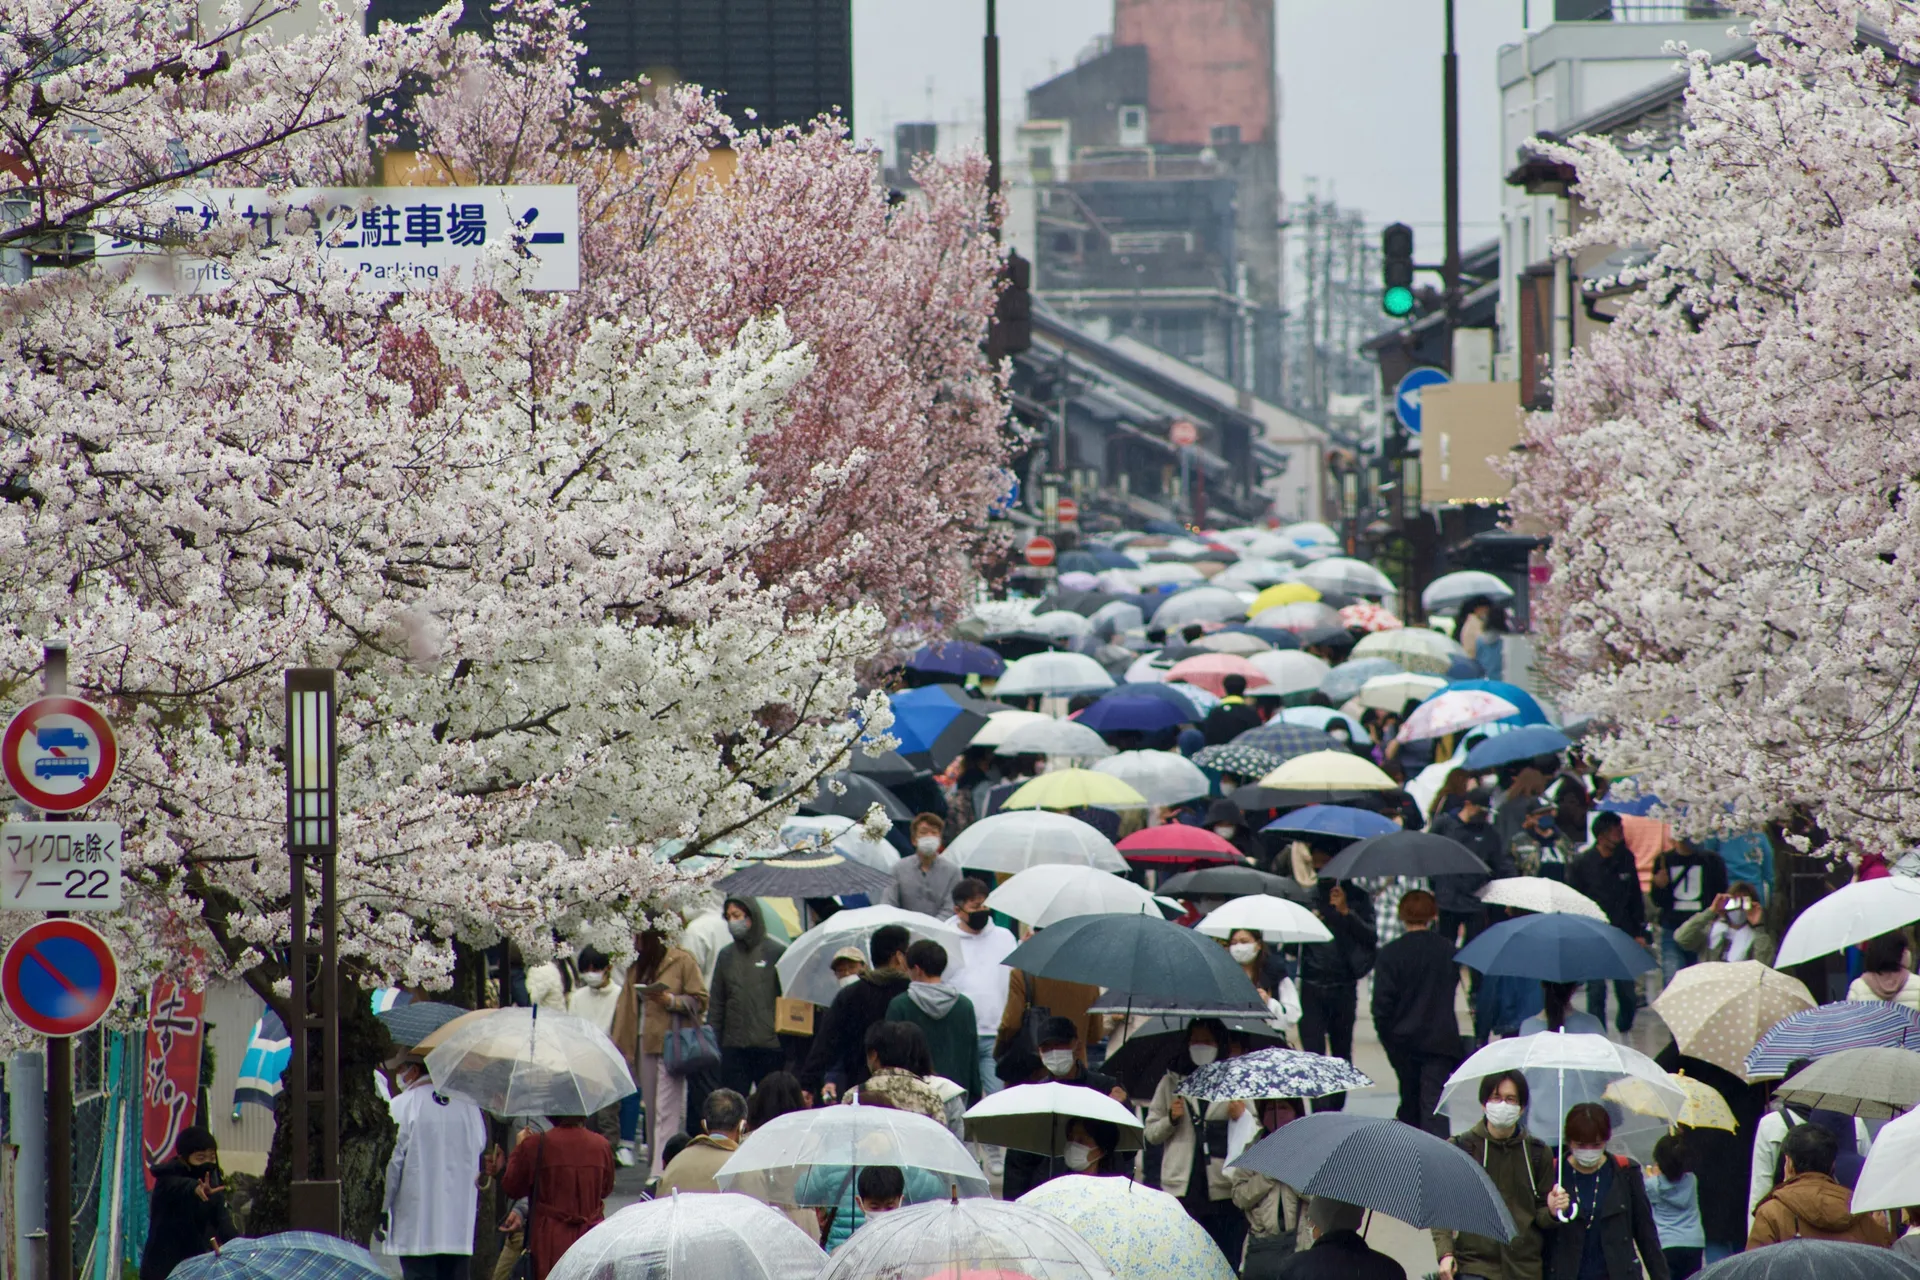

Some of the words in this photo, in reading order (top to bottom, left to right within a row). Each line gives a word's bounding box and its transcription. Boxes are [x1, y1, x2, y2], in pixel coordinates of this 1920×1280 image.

[6, 833, 115, 863] マイクロを除く
